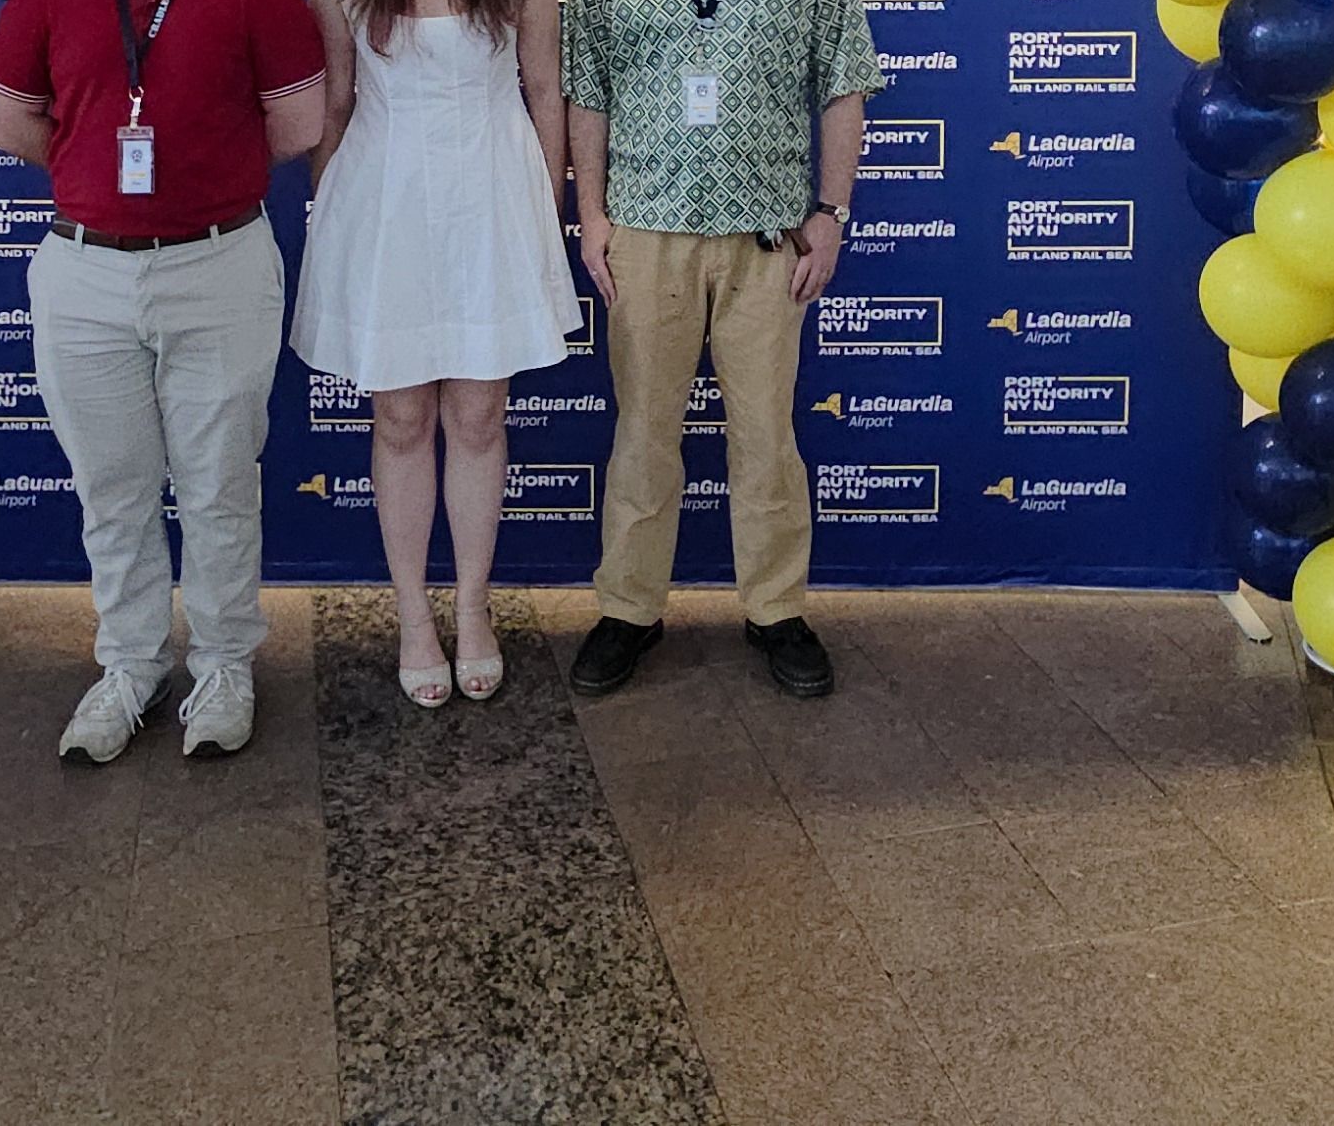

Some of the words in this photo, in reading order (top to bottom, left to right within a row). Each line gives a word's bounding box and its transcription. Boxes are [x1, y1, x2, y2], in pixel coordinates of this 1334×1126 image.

[148, 0, 170, 38] CRADLE
[1010, 32, 1061, 45] PORT
[1009, 43, 1120, 56] AUTHORITY
[1010, 55, 1036, 68] NY
[1039, 57, 1060, 68] NJ
[1009, 82, 1031, 92] AIR
[1035, 82, 1072, 92] LAND
[1075, 82, 1105, 92] RAIL
[1109, 82, 1135, 92] SEA
[817, 297, 869, 308] PORT
[818, 309, 927, 320] AUTHORITY
[1026, 311, 1131, 328] LaGuardia
[819, 319, 845, 331] NY
[848, 319, 868, 331] NJ
[1025, 331, 1071, 345] Airport
[819, 347, 840, 355] AIR
[844, 347, 879, 355] LAND
[883, 347, 912, 355] RAIL
[915, 347, 941, 355] SEA
[506, 394, 606, 411] LaGuardia
[849, 395, 952, 411] LaGuardia
[504, 414, 548, 429] Airport
[848, 415, 893, 429] Airport
